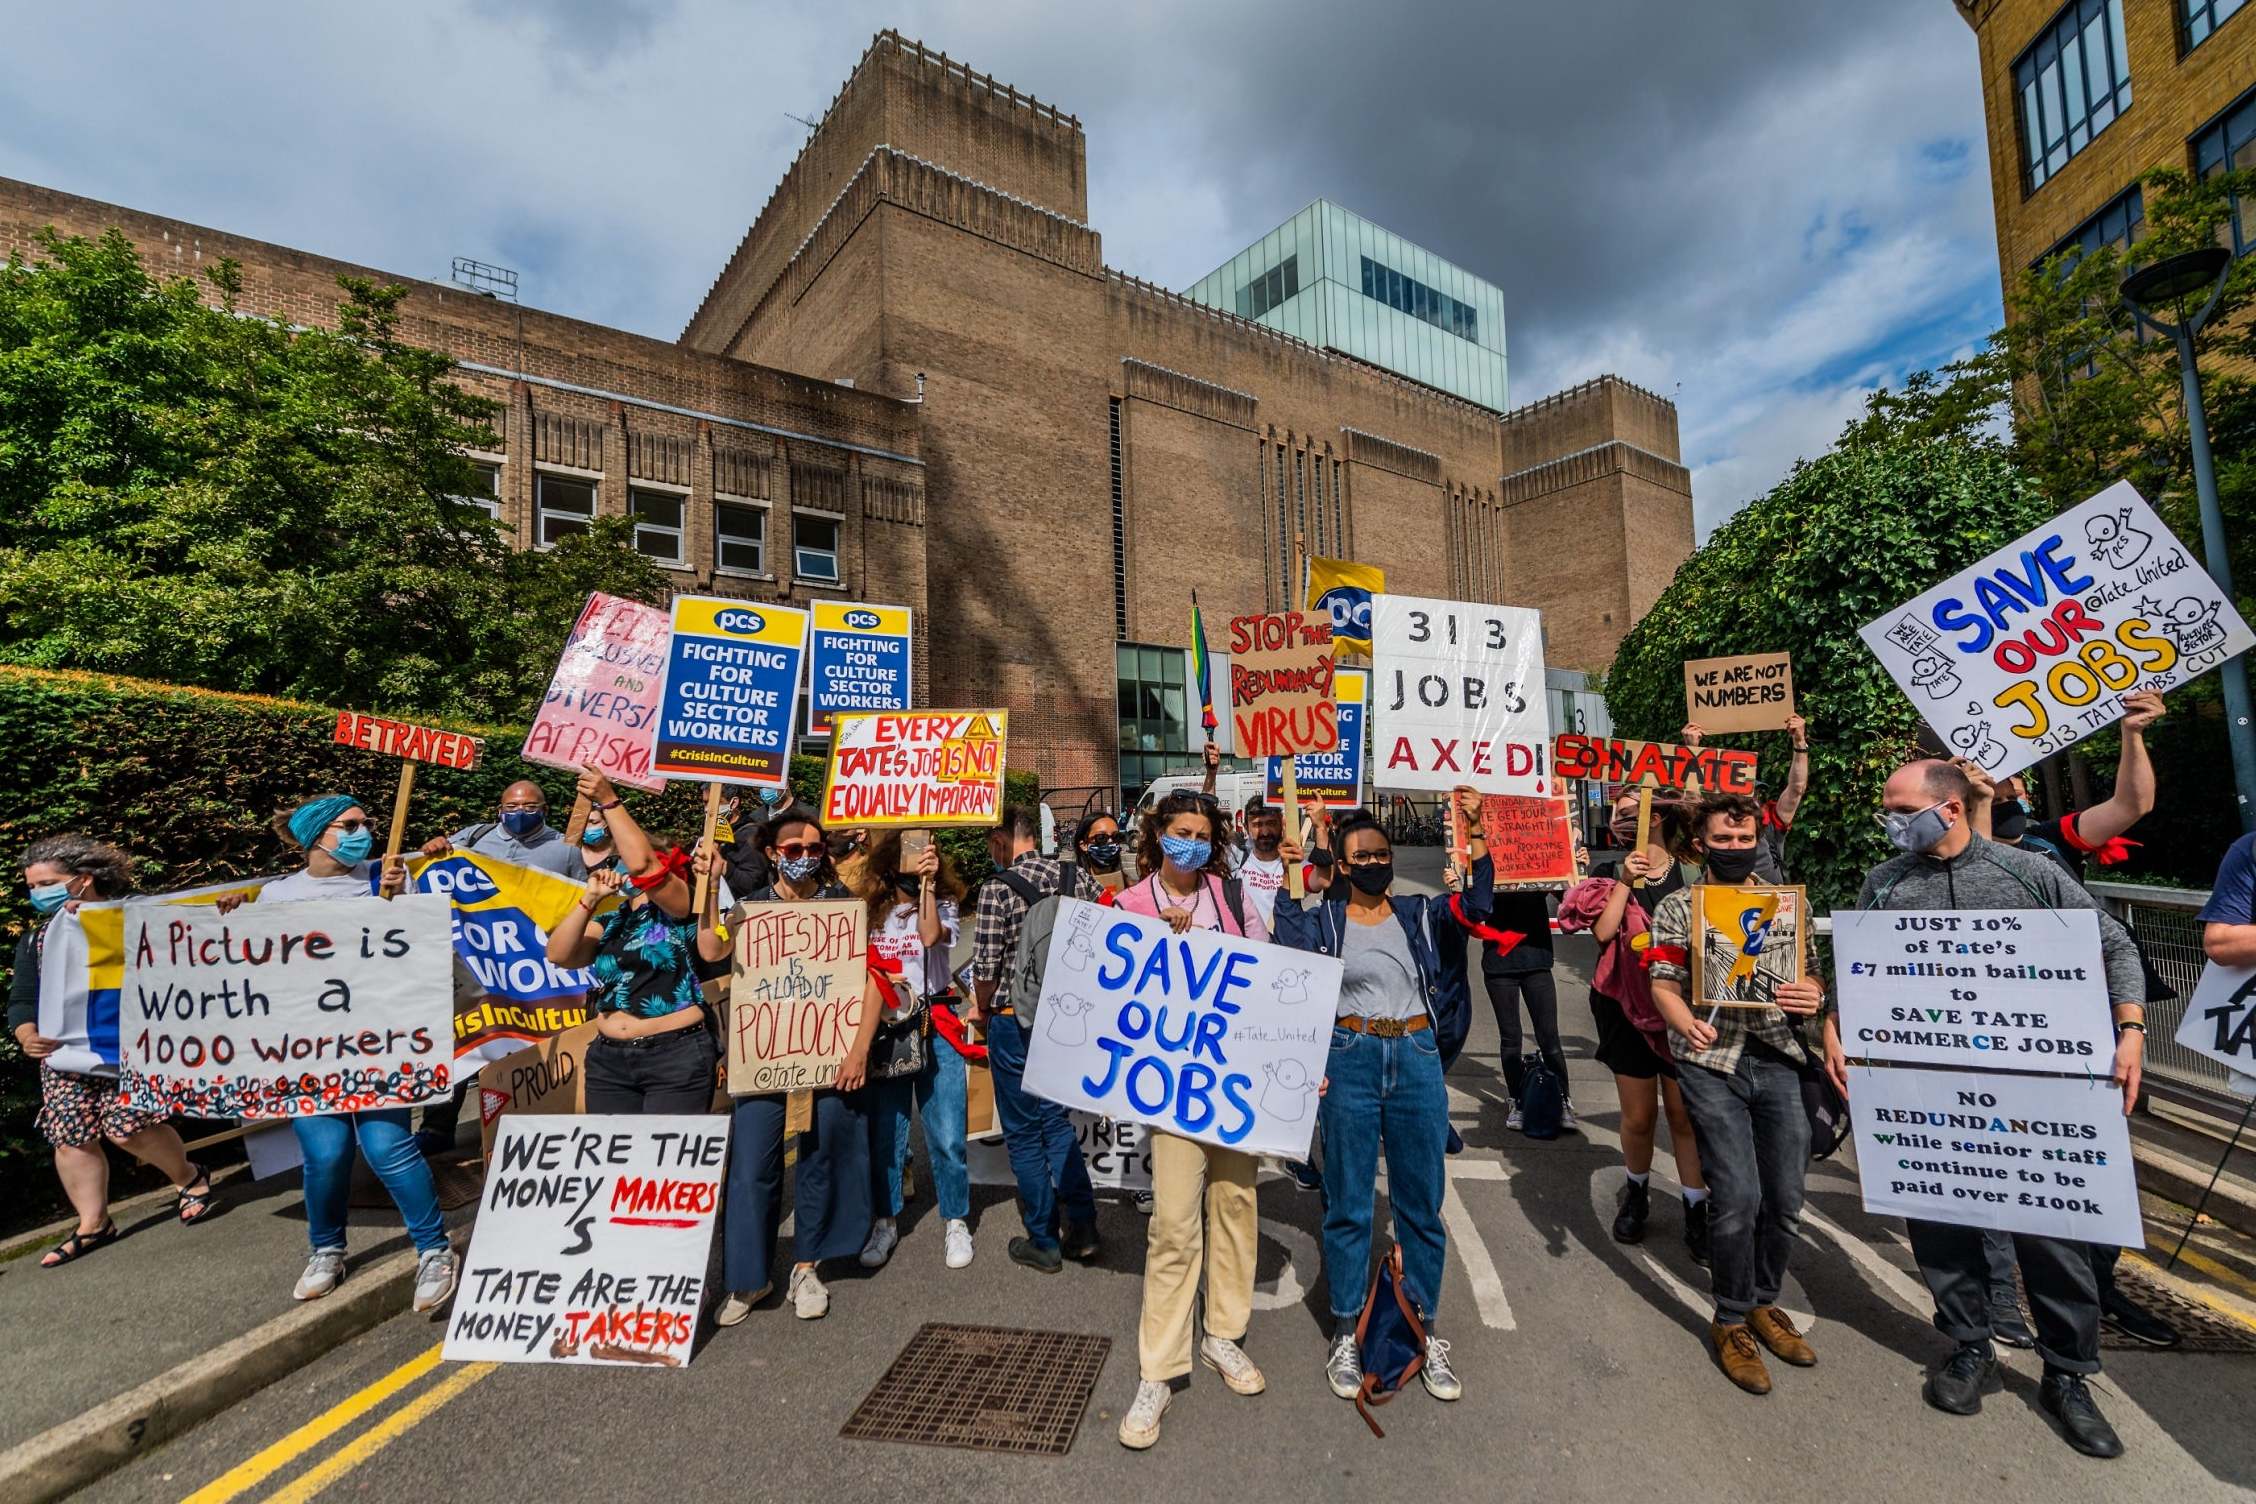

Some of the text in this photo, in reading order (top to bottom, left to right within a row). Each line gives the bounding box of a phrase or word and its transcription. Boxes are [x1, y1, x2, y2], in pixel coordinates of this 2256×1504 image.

[2084, 547, 2189, 612] @Tate_United
[1932, 534, 2094, 654] SAVE
[720, 612, 761, 632] pcs
[848, 613, 877, 627] pcs
[1230, 611, 1333, 655] STOP THE
[823, 636, 900, 654] FIGHTING
[1909, 630, 1932, 652] TATE
[1993, 598, 2105, 674] OUR
[682, 643, 787, 670] FIGHTING
[845, 653, 878, 666] FOR
[614, 675, 645, 693] AND
[709, 665, 753, 685] FOR
[825, 666, 897, 681] CULTURE
[1694, 663, 1788, 687] WE ARE NOT
[1929, 673, 1950, 689] TATE
[1992, 617, 2179, 739] JOBS
[679, 682, 779, 708] CULTURE
[829, 680, 893, 695] SECTOR
[1390, 670, 1527, 714] JOBS
[1694, 683, 1786, 709] NUMBERS
[2033, 725, 2078, 755] 313
[2186, 642, 2228, 673] CUT
[682, 702, 768, 726] SECTOR
[819, 694, 902, 710] WORKERS
[334, 711, 475, 769] BETRAYED
[528, 721, 575, 755] AT
[668, 720, 780, 747] WORKERS
[875, 715, 966, 742] EVERY
[1235, 700, 1338, 759] VIRUS
[670, 749, 769, 768] #CrisisInCulture
[836, 740, 999, 779] TATE'S JOB IS NOT
[1293, 753, 1344, 765] ECTOR
[1387, 736, 1544, 793] AXED!
[828, 779, 997, 820] EQUALLY IMPORTANT
[1497, 809, 1516, 821] GET
[1521, 807, 1546, 819] YOUR
[1488, 837, 1521, 848] ULTURAL
[1895, 916, 2023, 931] JUST 10%
[136, 920, 411, 970] A Picture is
[734, 910, 867, 968] TATE'S DEAL
[1905, 940, 2017, 955] of Tate's
[789, 958, 804, 976] IS
[1097, 922, 1259, 1015] SAVE
[1851, 962, 2087, 981] £7 million bailout
[317, 978, 351, 1013] a
[755, 974, 834, 1001] A LOAD OF
[1950, 987, 1978, 1001] to
[1891, 1007, 2049, 1028] SAVE TATE
[1117, 1000, 1228, 1066] OUR
[1233, 1026, 1317, 1044] #Tate_United
[1858, 1028, 2094, 1055] COMMERCE JOBS
[136, 1028, 235, 1068] 1000
[511, 1051, 575, 1109] PROUD
[1081, 1036, 1256, 1145] JOBS
[1958, 1091, 1997, 1107] NO
[1875, 1108, 2097, 1139] REDUNDANCIES
[500, 1126, 726, 1172] WE'RE THE
[1873, 1132, 2108, 1166] while senior staff
[1898, 1157, 2086, 1188] continue to be
[490, 1174, 719, 1227] MONEY MAKERS
[1891, 1180, 2103, 1215] paid over £100k
[471, 1268, 702, 1308] TATE ARE THE
[454, 1308, 692, 1354] MONEY TAKERS
